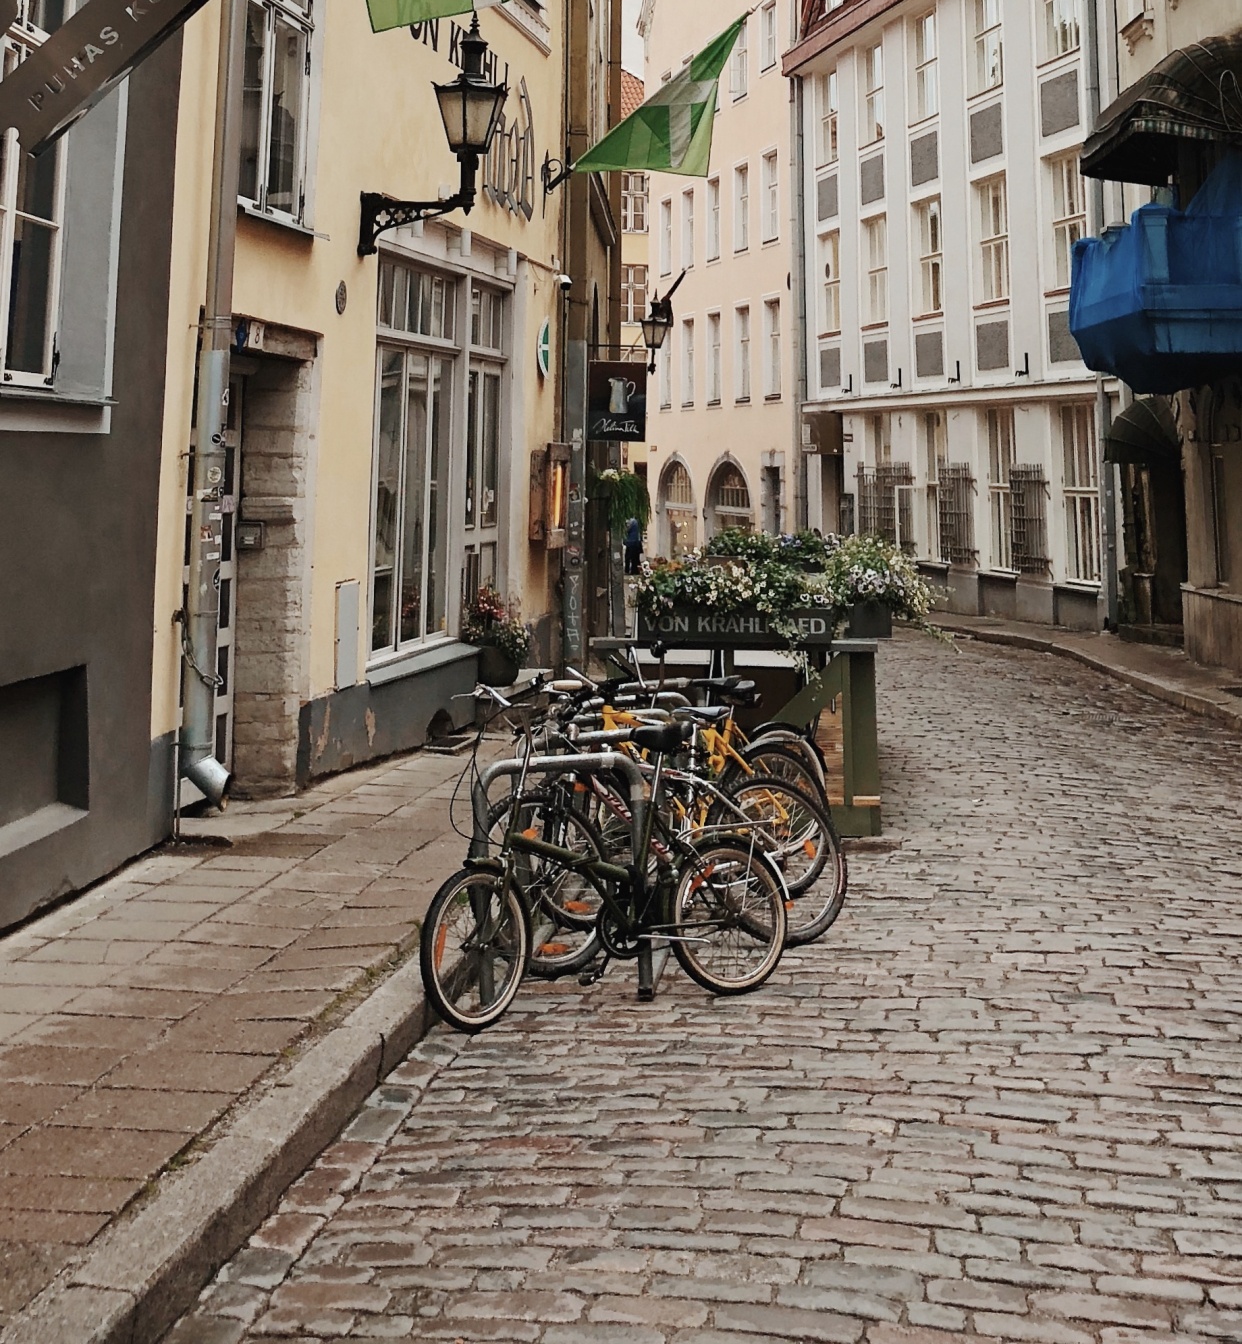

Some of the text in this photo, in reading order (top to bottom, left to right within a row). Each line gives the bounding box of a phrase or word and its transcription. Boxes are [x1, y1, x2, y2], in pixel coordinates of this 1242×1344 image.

[27, 26, 119, 111] PUHAS
[254, 326, 261, 344] 8
[644, 615, 689, 633] VON
